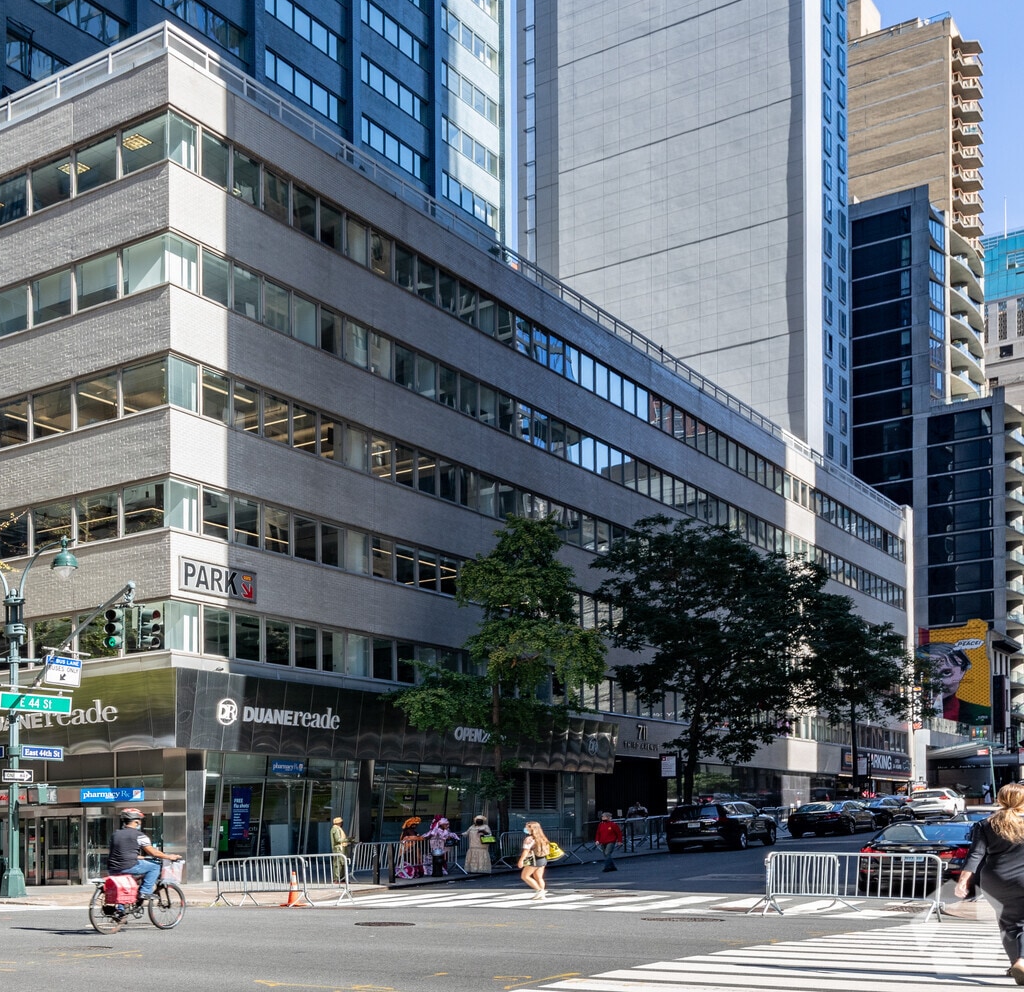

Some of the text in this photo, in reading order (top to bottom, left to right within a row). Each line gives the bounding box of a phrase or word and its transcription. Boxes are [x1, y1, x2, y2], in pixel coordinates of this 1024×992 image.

[184, 562, 238, 595] PARK
[19, 699, 52, 710] E 44 St
[24, 749, 39, 757] East
[39, 750, 53, 758] 44th
[83, 790, 120, 800] pharmacy
